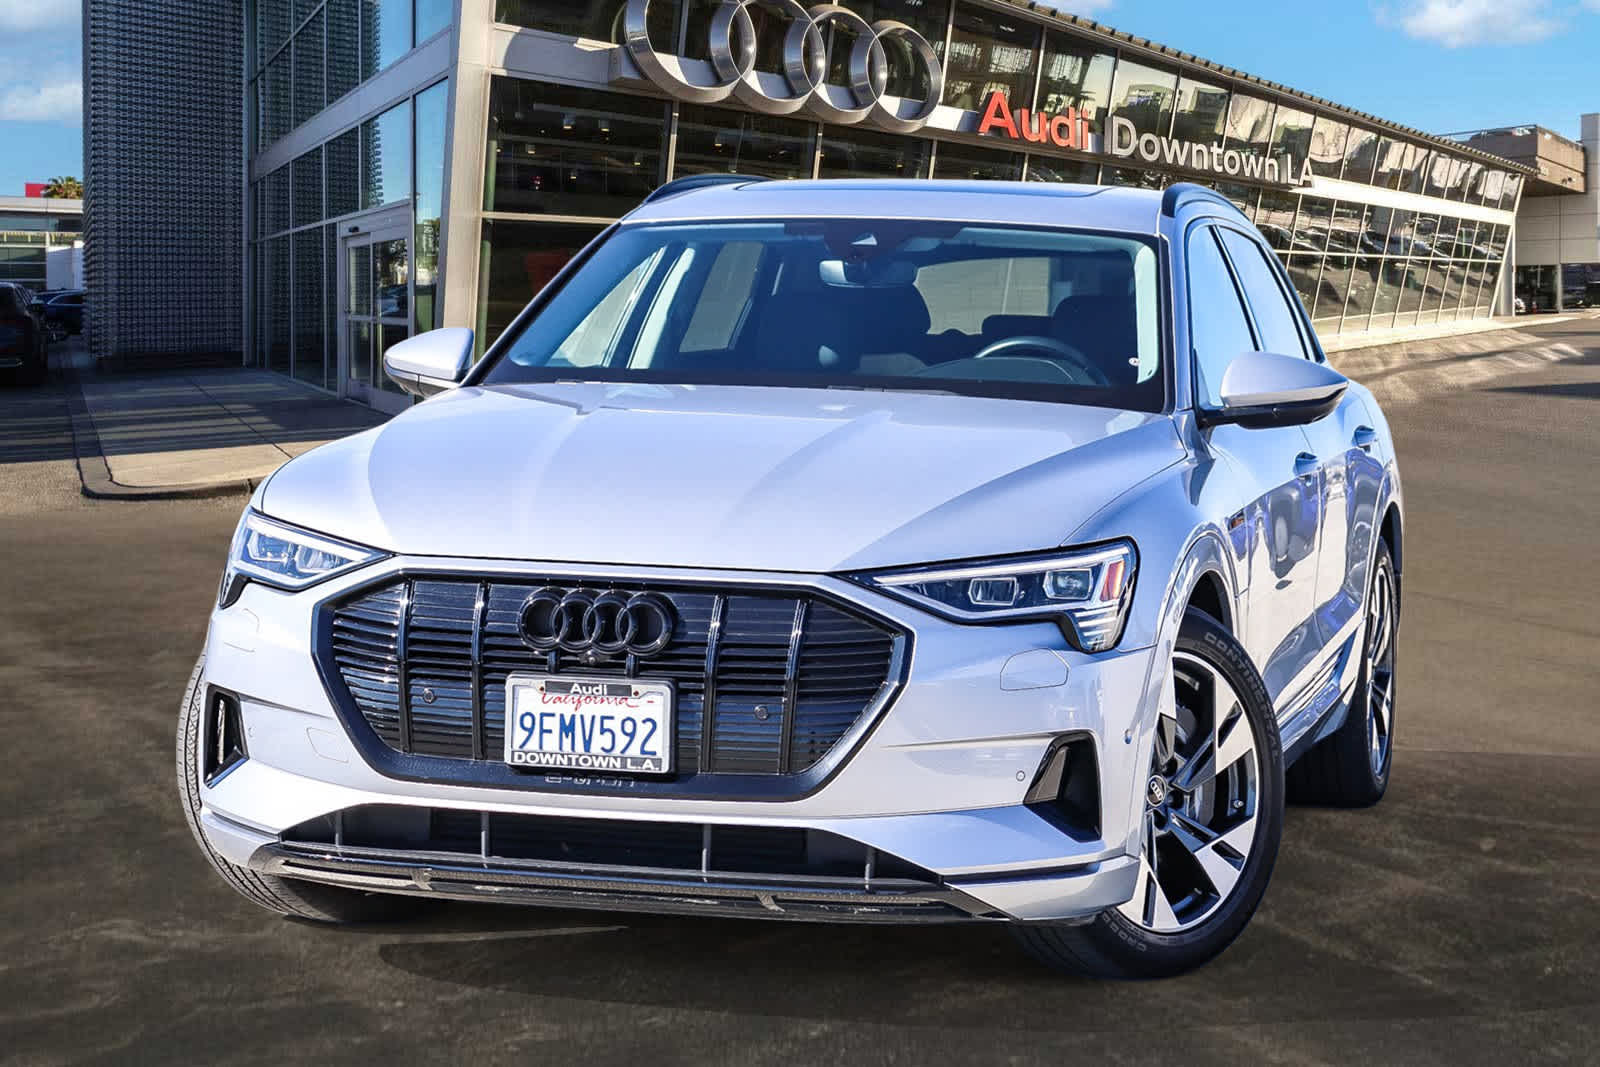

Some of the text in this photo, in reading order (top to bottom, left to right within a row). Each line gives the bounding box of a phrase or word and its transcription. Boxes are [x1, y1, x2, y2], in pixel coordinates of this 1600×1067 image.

[978, 91, 1315, 188] Audi Downtown LA
[570, 683, 608, 696] Audi
[518, 711, 658, 756] 9FMV592
[513, 751, 660, 771] DOWNTOWN L.A.
